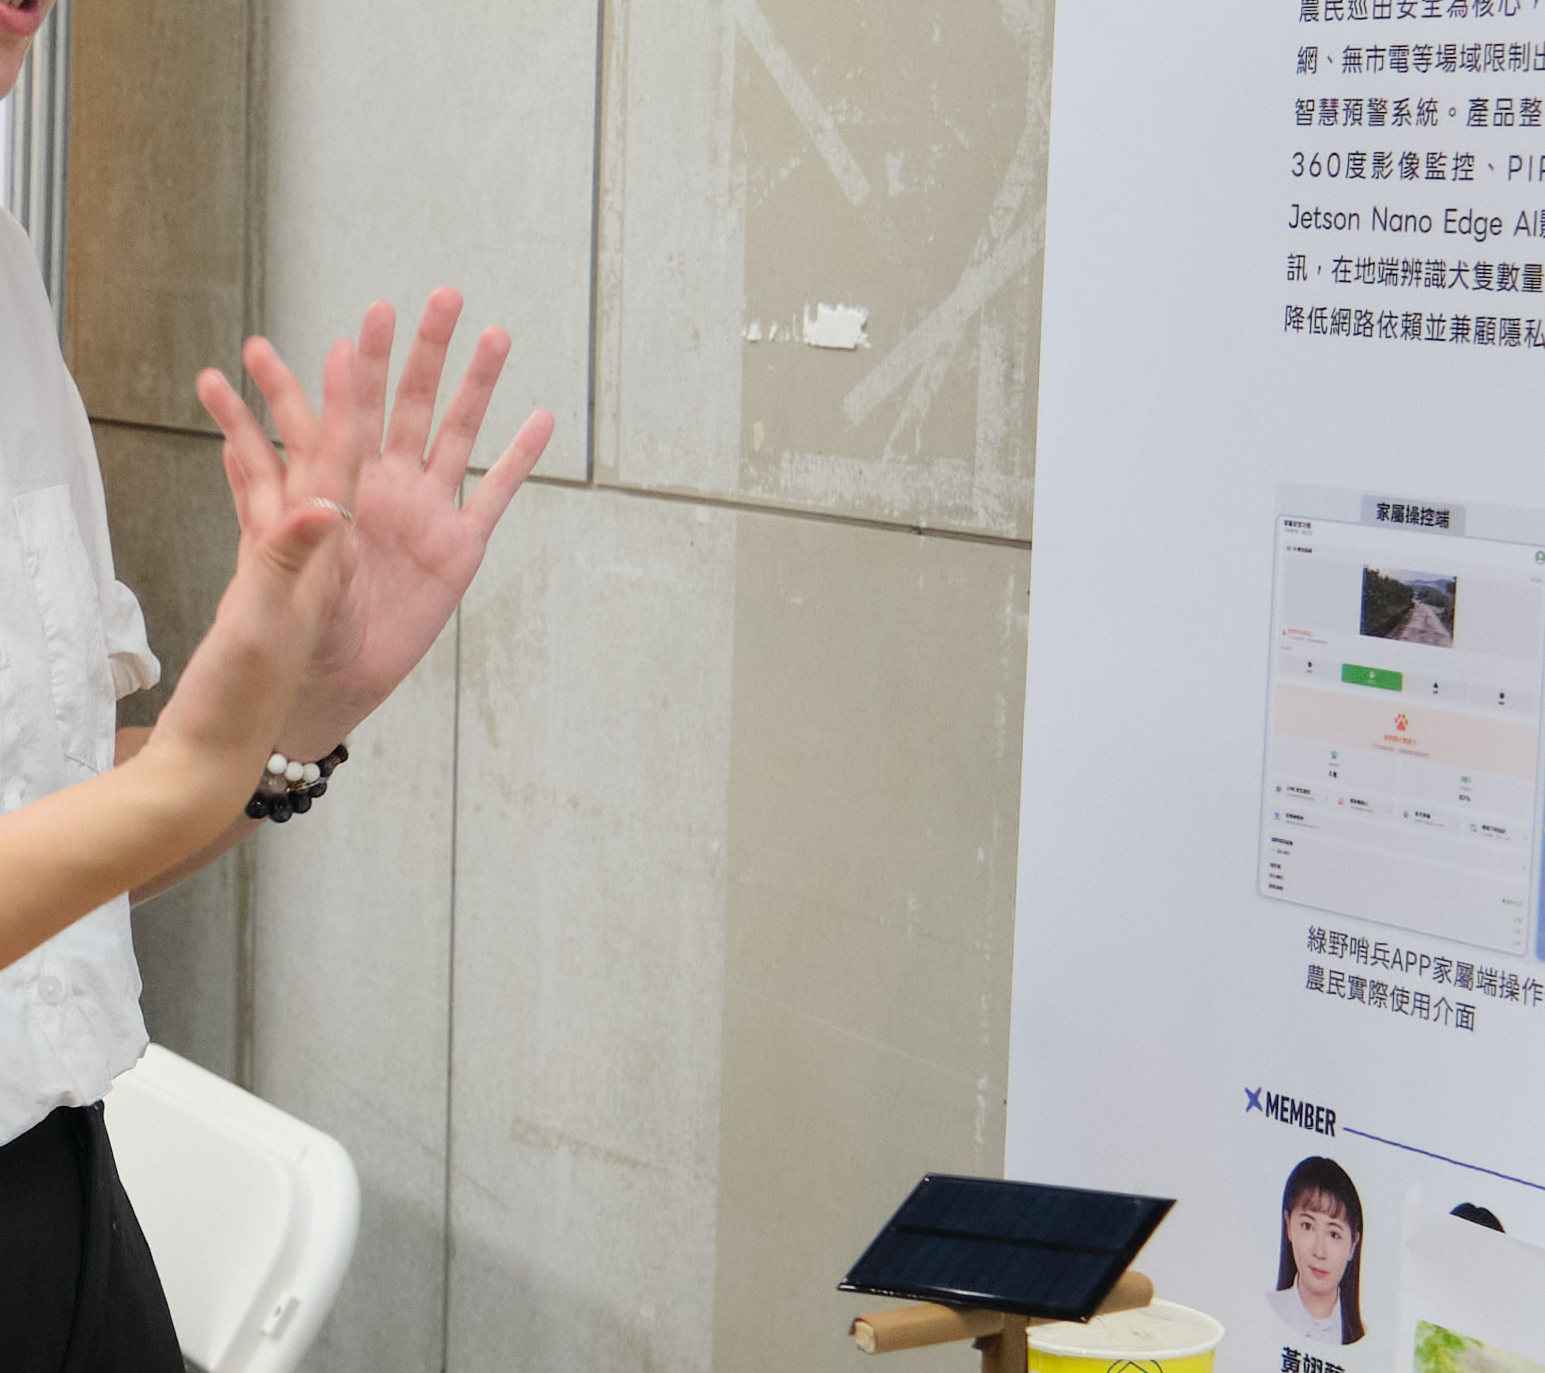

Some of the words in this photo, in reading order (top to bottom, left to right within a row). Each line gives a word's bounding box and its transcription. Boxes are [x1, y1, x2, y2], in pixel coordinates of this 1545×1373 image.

[1288, 204, 1361, 232] Jetson
[1371, 206, 1433, 235] Nano
[1443, 208, 1503, 243] Edge
[1375, 502, 1452, 530] 家屬操控端
[1306, 964, 1477, 1032] 農民實際使用介面
[1264, 1090, 1336, 1137] MEMBER
